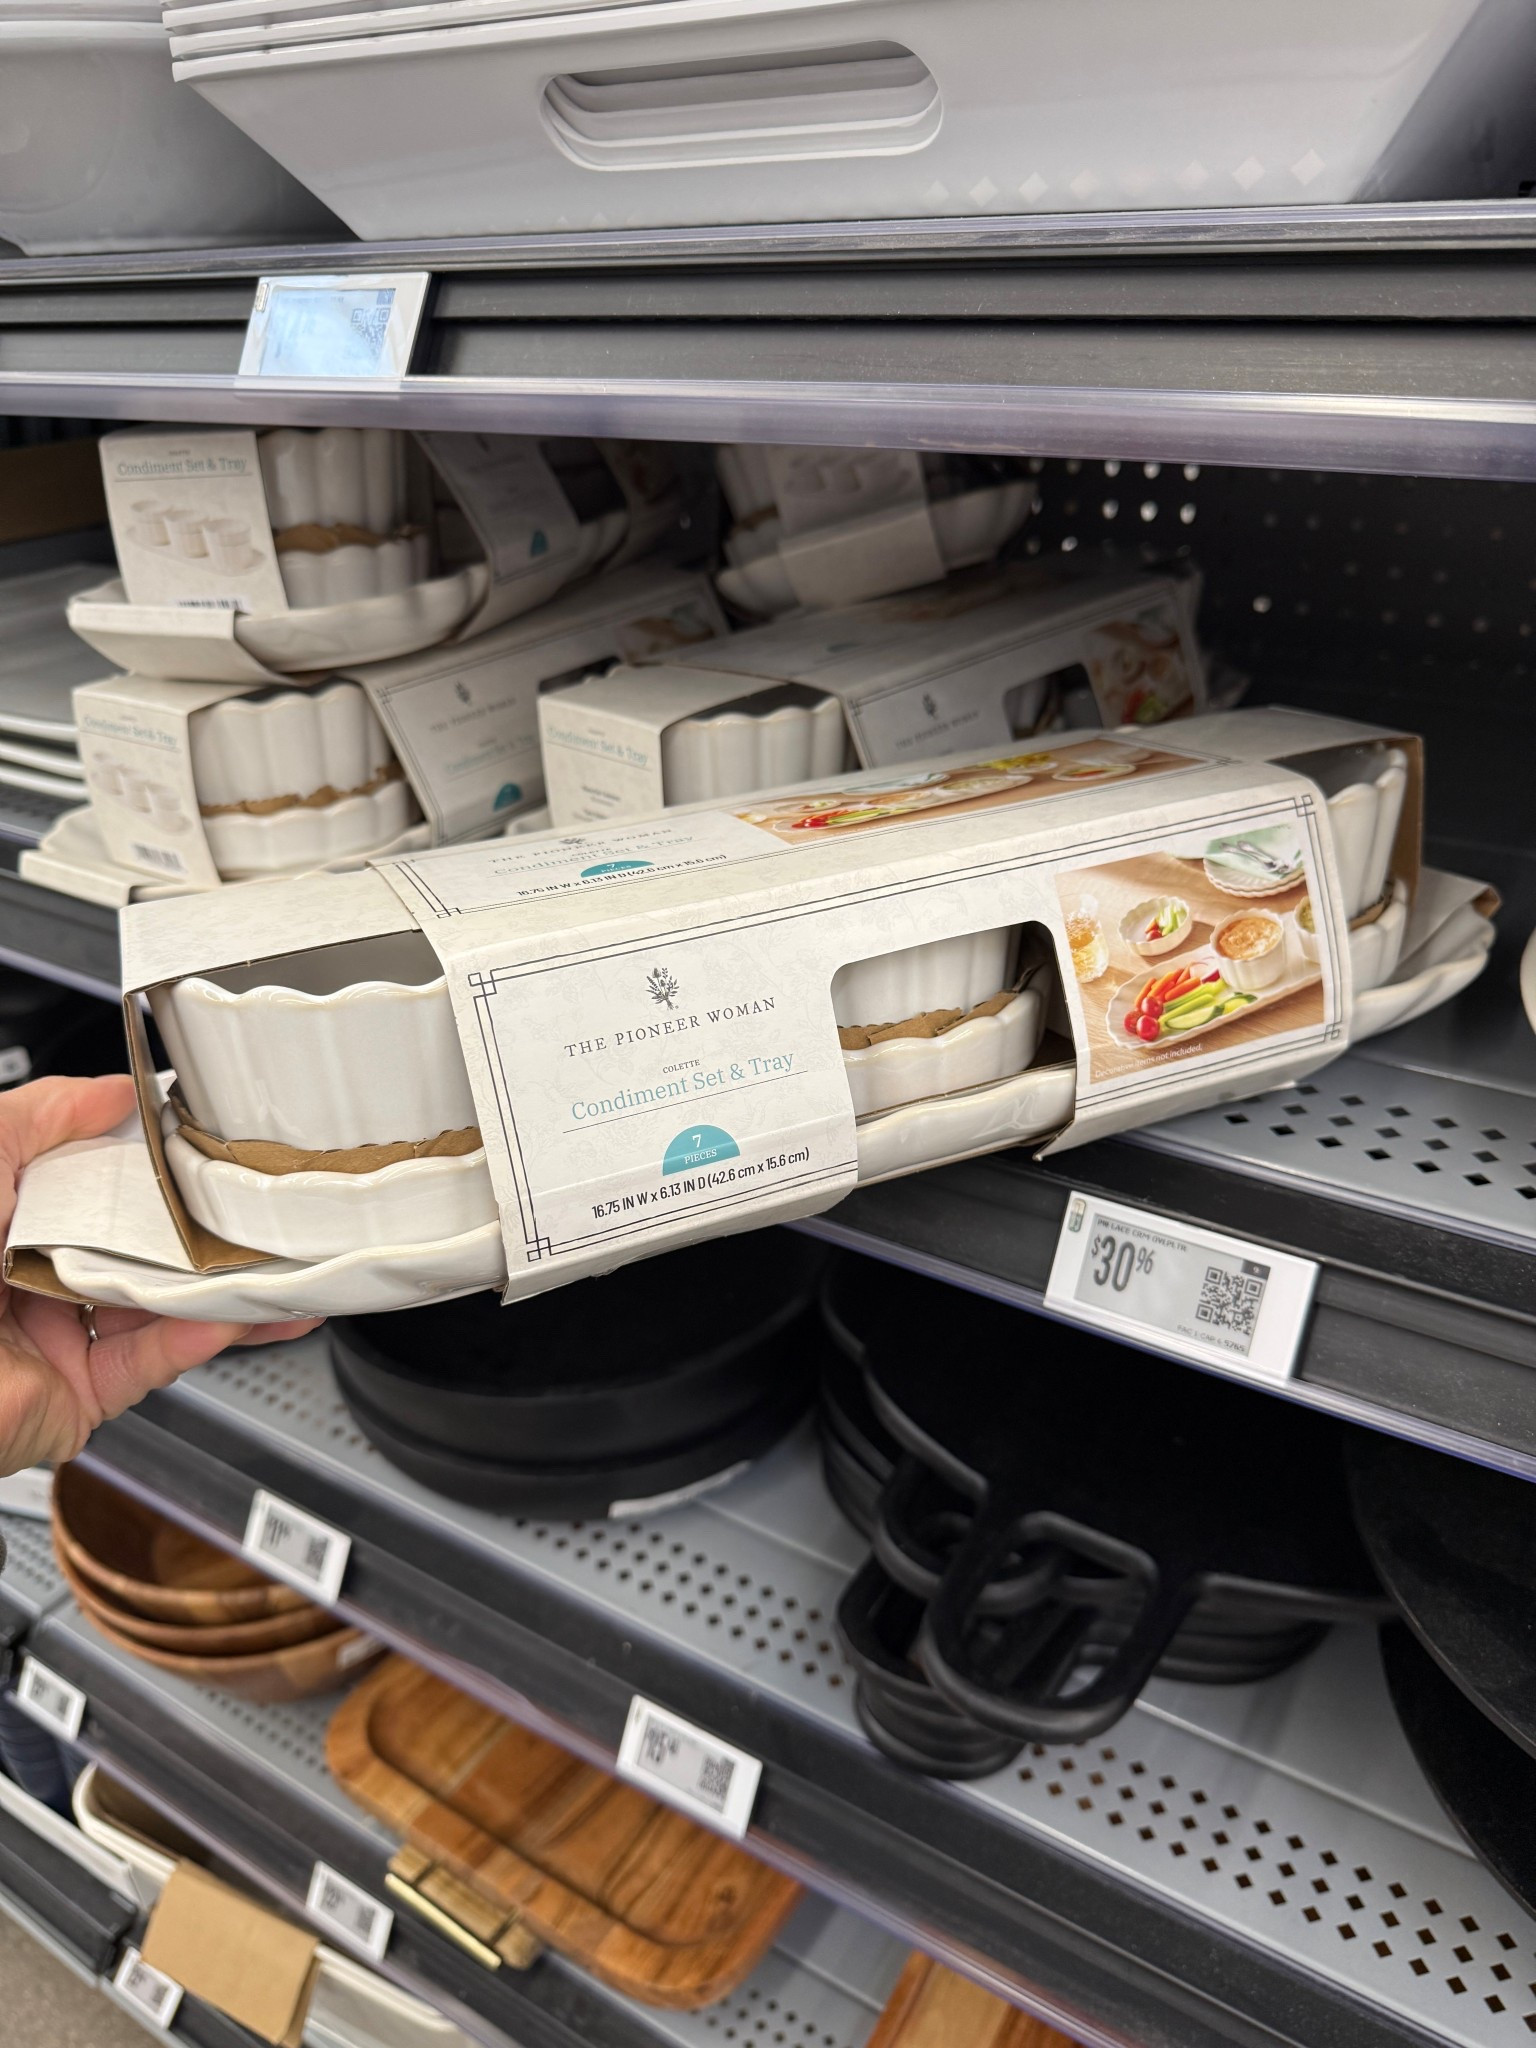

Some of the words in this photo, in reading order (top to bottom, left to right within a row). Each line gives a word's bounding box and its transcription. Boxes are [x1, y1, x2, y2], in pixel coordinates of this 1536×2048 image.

[612, 828, 672, 842] WOMAN
[564, 1037, 607, 1057] THE
[615, 1015, 701, 1046] PIONEER
[706, 997, 776, 1024] WOMAN
[1156, 1052, 1170, 1061] not
[1169, 1043, 1203, 1059] included.
[662, 1059, 700, 1074] COLETTE
[572, 1077, 689, 1120] Condiment
[693, 1068, 726, 1090] Set
[730, 1063, 746, 1081] &
[748, 1053, 794, 1076] Tray
[692, 1134, 702, 1148] 7
[684, 1148, 717, 1164] PIECES
[591, 1200, 620, 1219] 16.75
[622, 1195, 635, 1211] IN
[636, 1192, 648, 1206] W
[650, 1192, 658, 1203] x
[660, 1182, 681, 1200] 6.13
[683, 1178, 696, 1194] IN
[698, 1176, 706, 1190] D
[708, 1168, 736, 1188] (42.6
[738, 1166, 756, 1179] cm
[757, 1163, 765, 1174] x
[766, 1154, 786, 1171] 15.6
[788, 1147, 810, 1164] cm)
